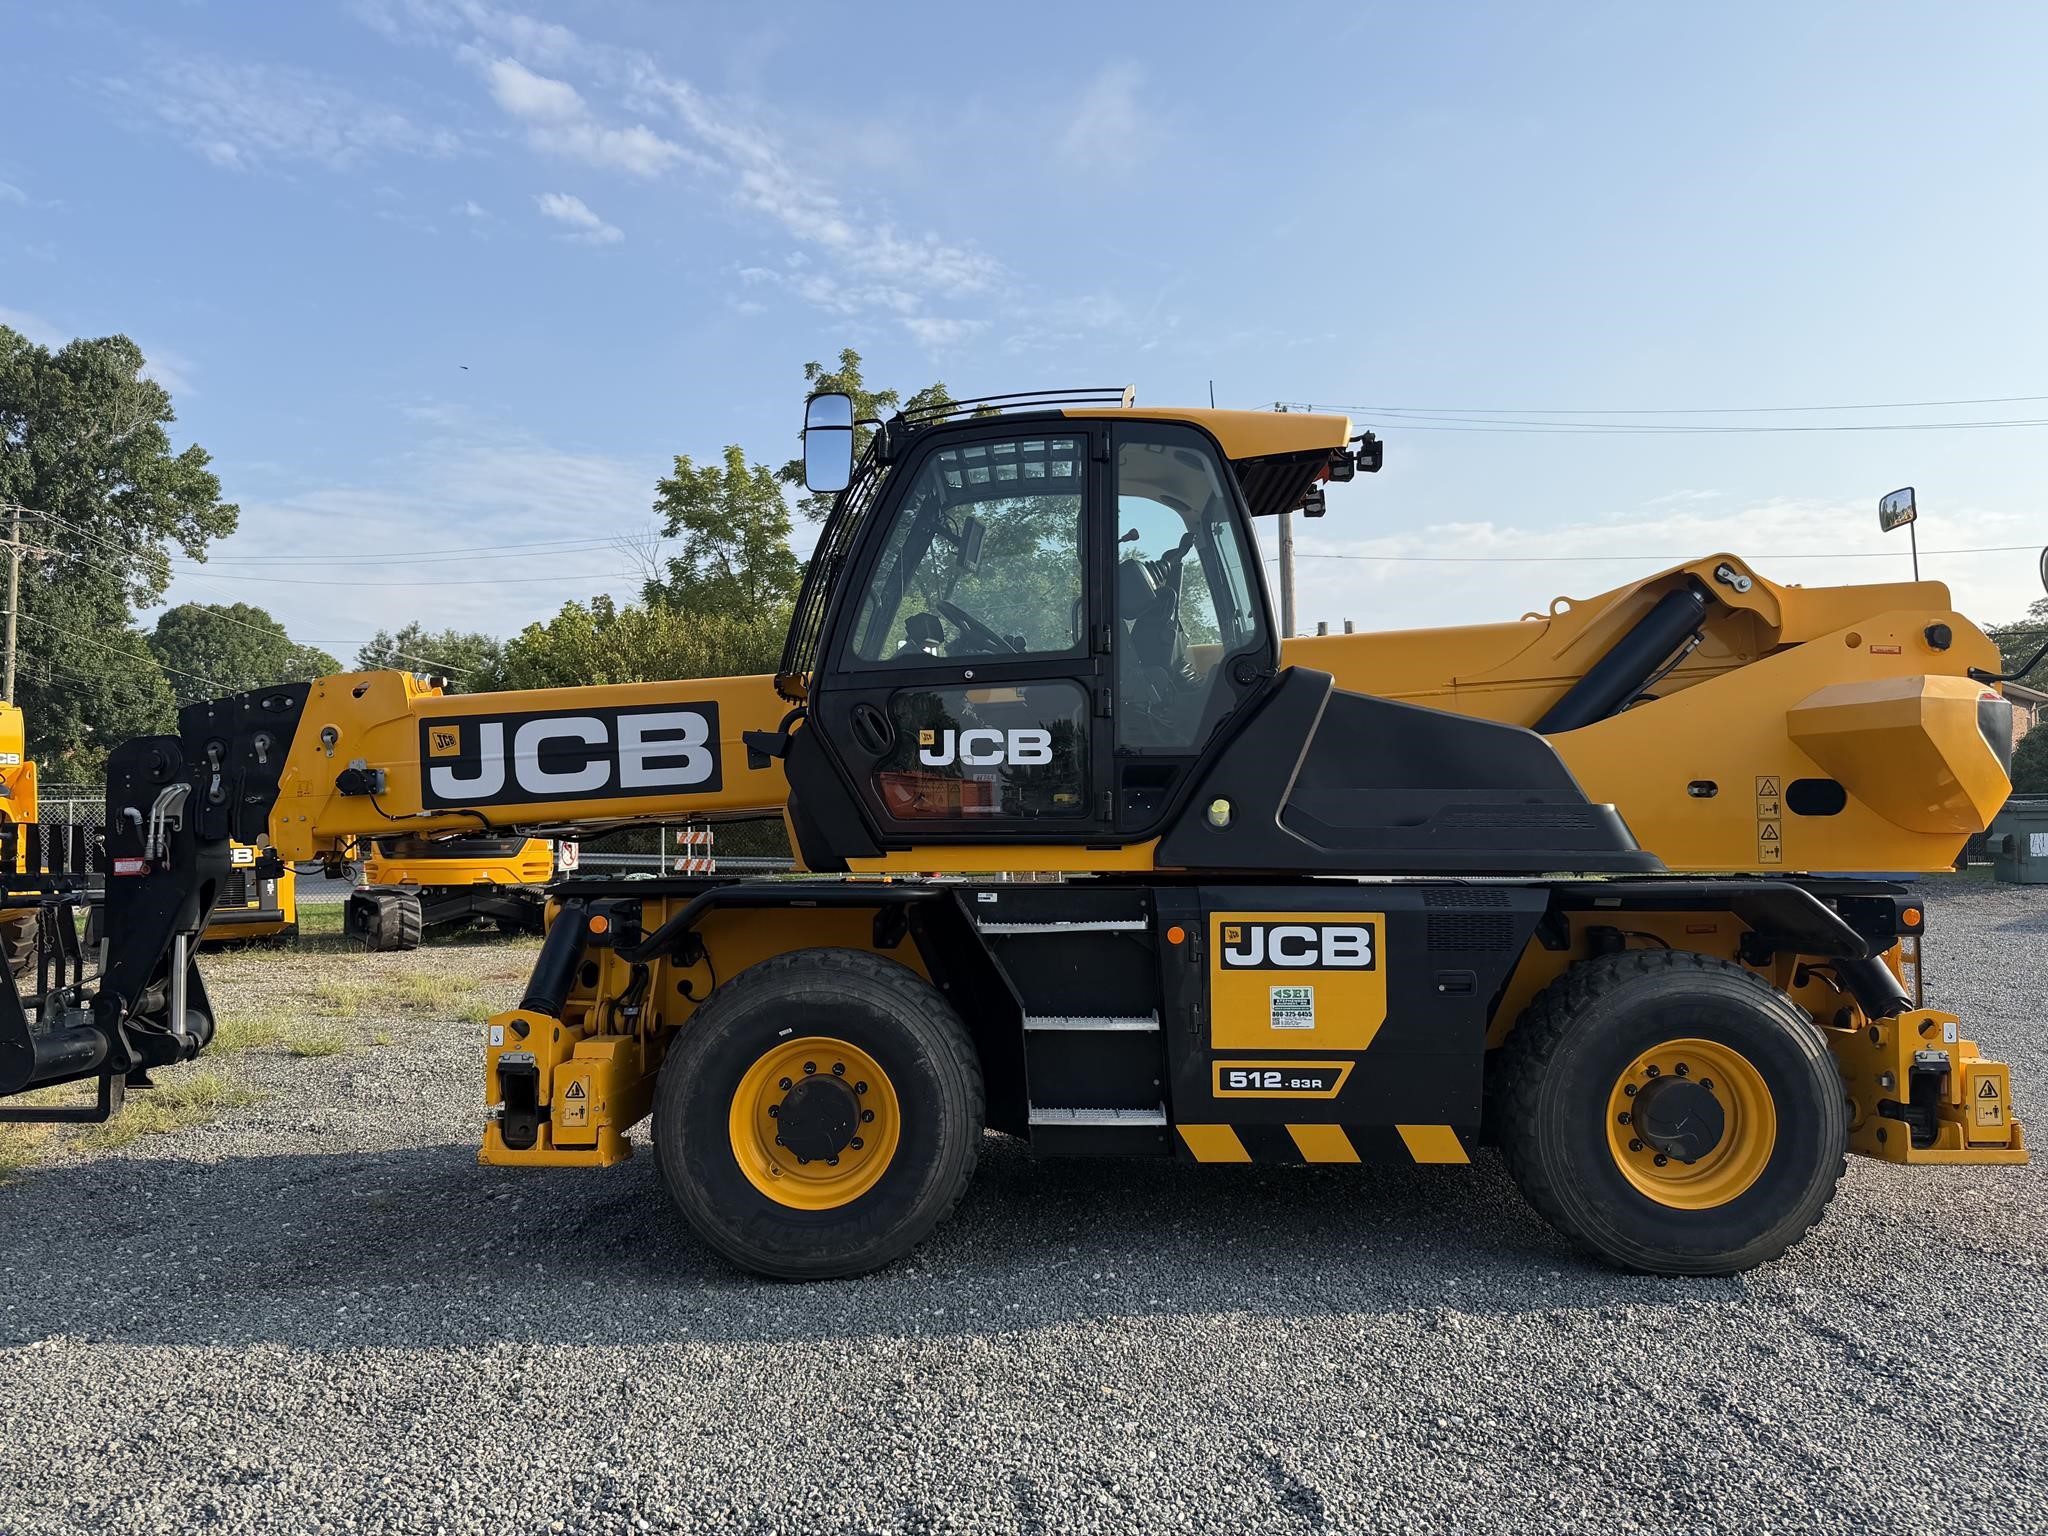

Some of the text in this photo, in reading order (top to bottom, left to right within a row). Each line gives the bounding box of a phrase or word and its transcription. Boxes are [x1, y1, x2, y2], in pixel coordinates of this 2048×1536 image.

[0, 753, 20, 765] CB
[430, 711, 714, 800] JCB
[919, 728, 1053, 766] JCB
[1225, 926, 1372, 966] JCB
